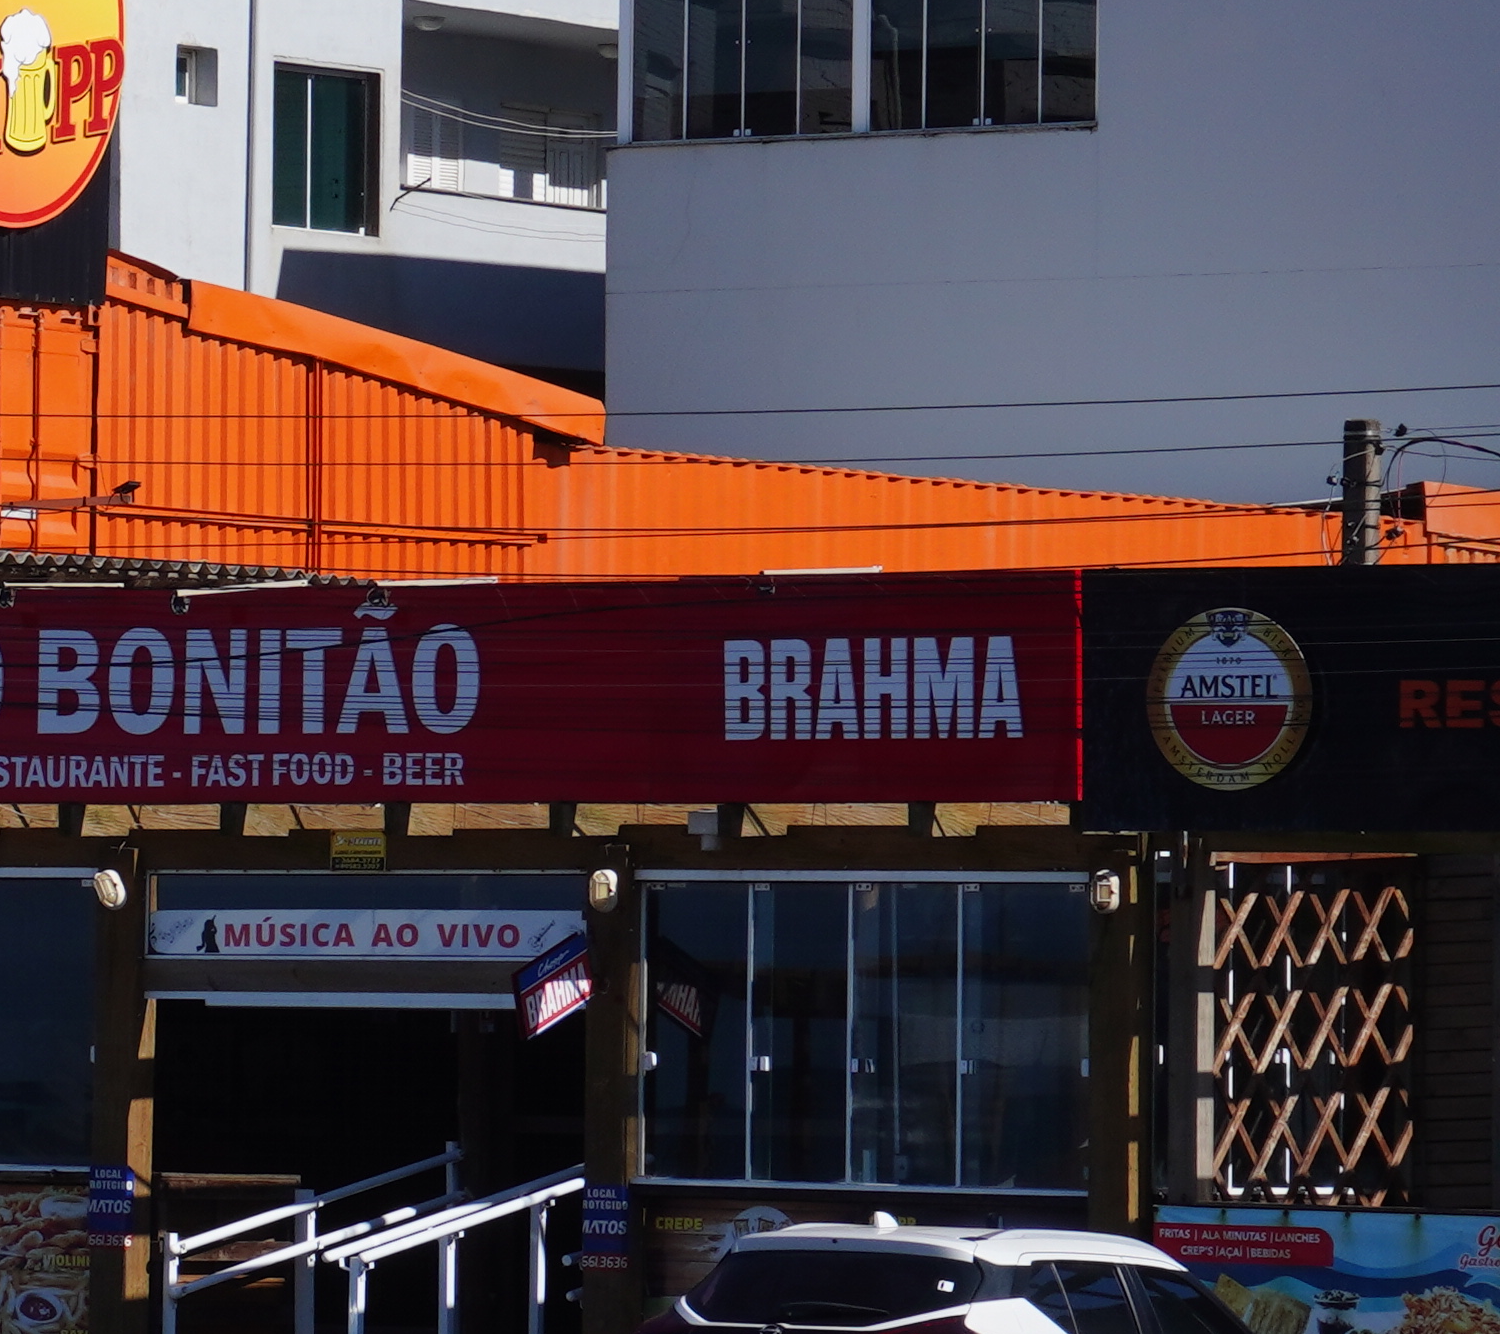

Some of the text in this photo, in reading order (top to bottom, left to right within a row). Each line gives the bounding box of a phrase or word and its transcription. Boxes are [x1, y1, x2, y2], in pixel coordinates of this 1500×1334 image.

[37, 601, 480, 736] BONITÃO
[723, 635, 1024, 741] BRAHMA
[1180, 675, 1278, 699] AMSTEL
[1201, 710, 1256, 725] LAGER
[191, 753, 264, 787] FAST
[272, 752, 354, 785] FOOD
[383, 752, 465, 786] BEER
[224, 916, 521, 948] MÚSICA AO VIVO
[525, 962, 592, 1030] BRAHMA
[94, 1169, 123, 1179] LOCAL
[587, 1188, 618, 1199] LOCAL
[655, 1216, 704, 1231] CREPE
[1158, 1228, 1191, 1239] FRITAS
[1201, 1230, 1221, 1240] ALA
[1223, 1231, 1267, 1242] MINUTAS
[1251, 1248, 1292, 1259] BEBIDAS
